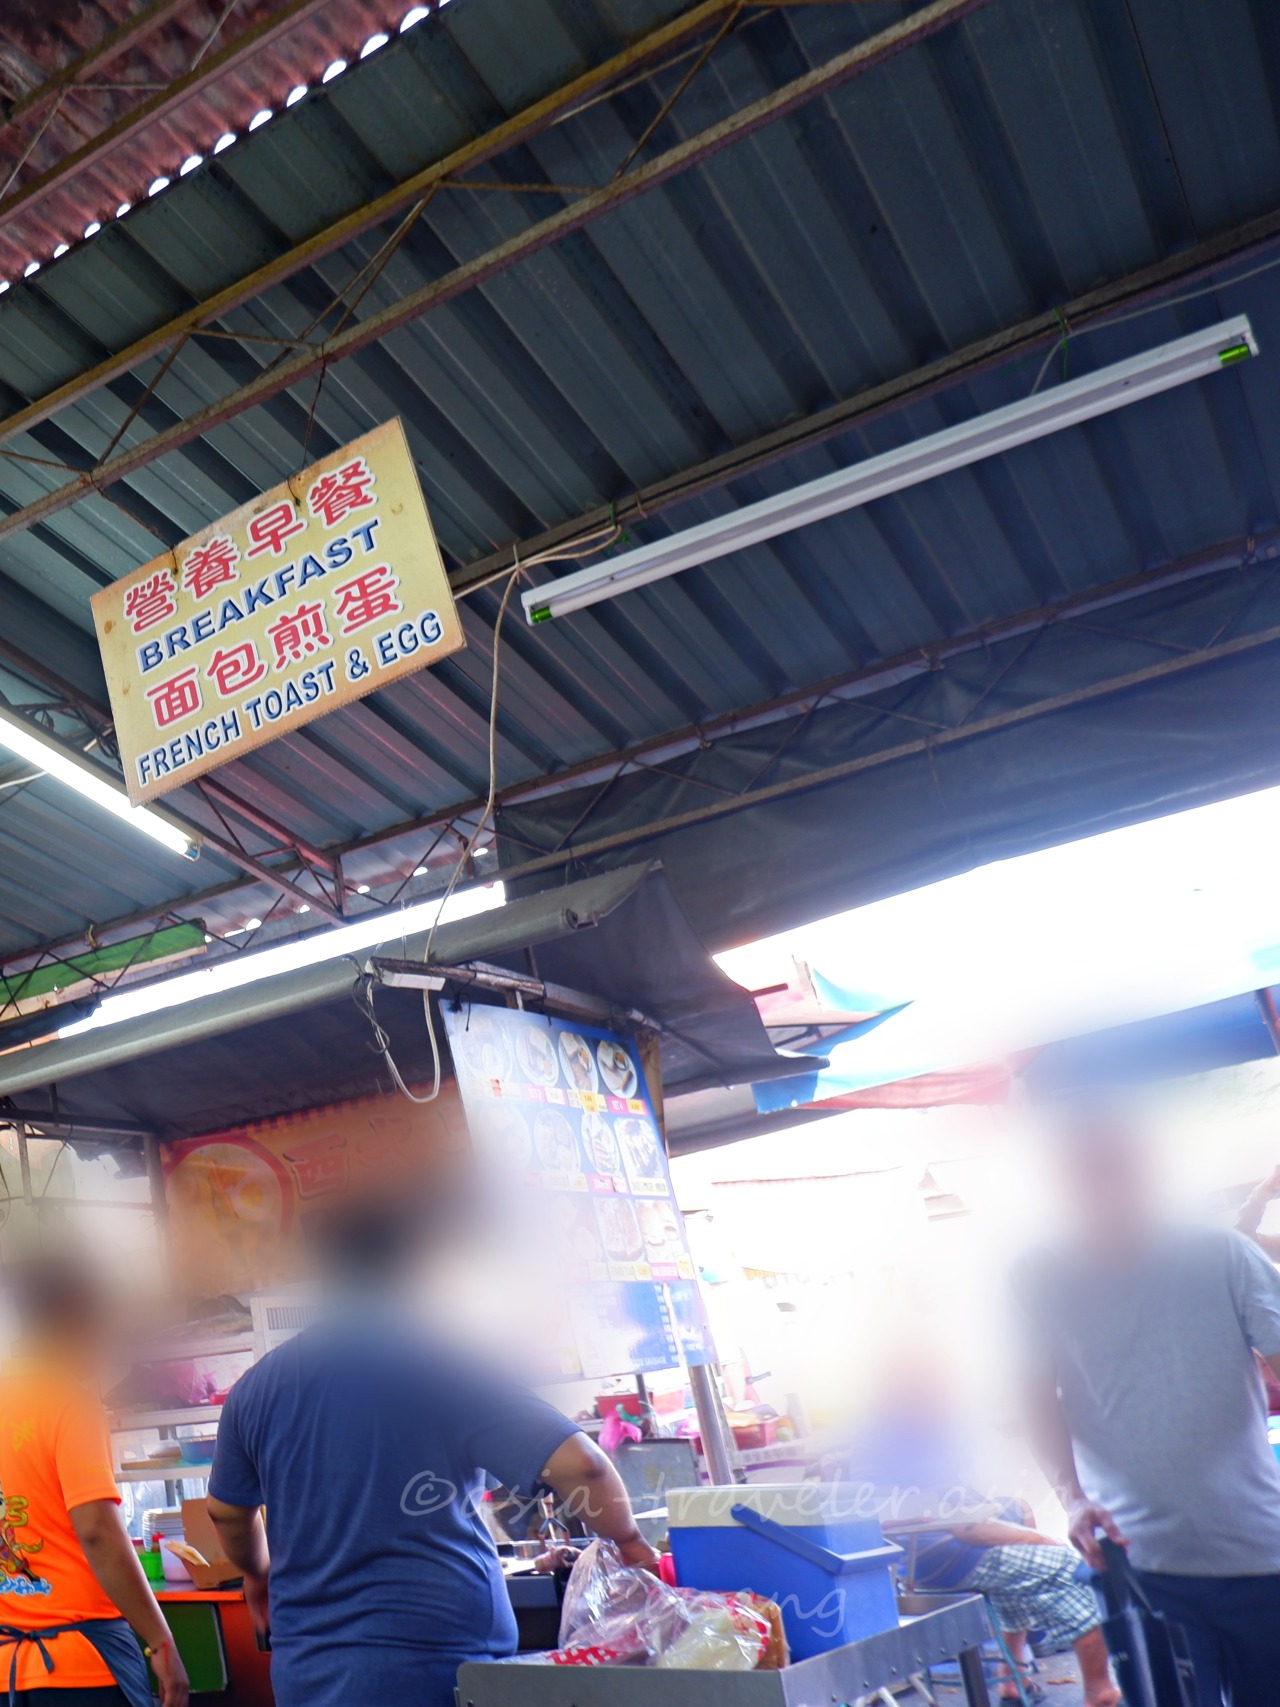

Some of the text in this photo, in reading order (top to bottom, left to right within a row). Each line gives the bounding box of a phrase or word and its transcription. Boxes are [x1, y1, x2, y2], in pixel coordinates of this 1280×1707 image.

[124, 457, 376, 634] 營養早餐
[140, 518, 380, 673] BREAKFAST
[138, 611, 442, 786] FRENCH TOAST & EGG
[146, 566, 400, 727] 面包煎蛋
